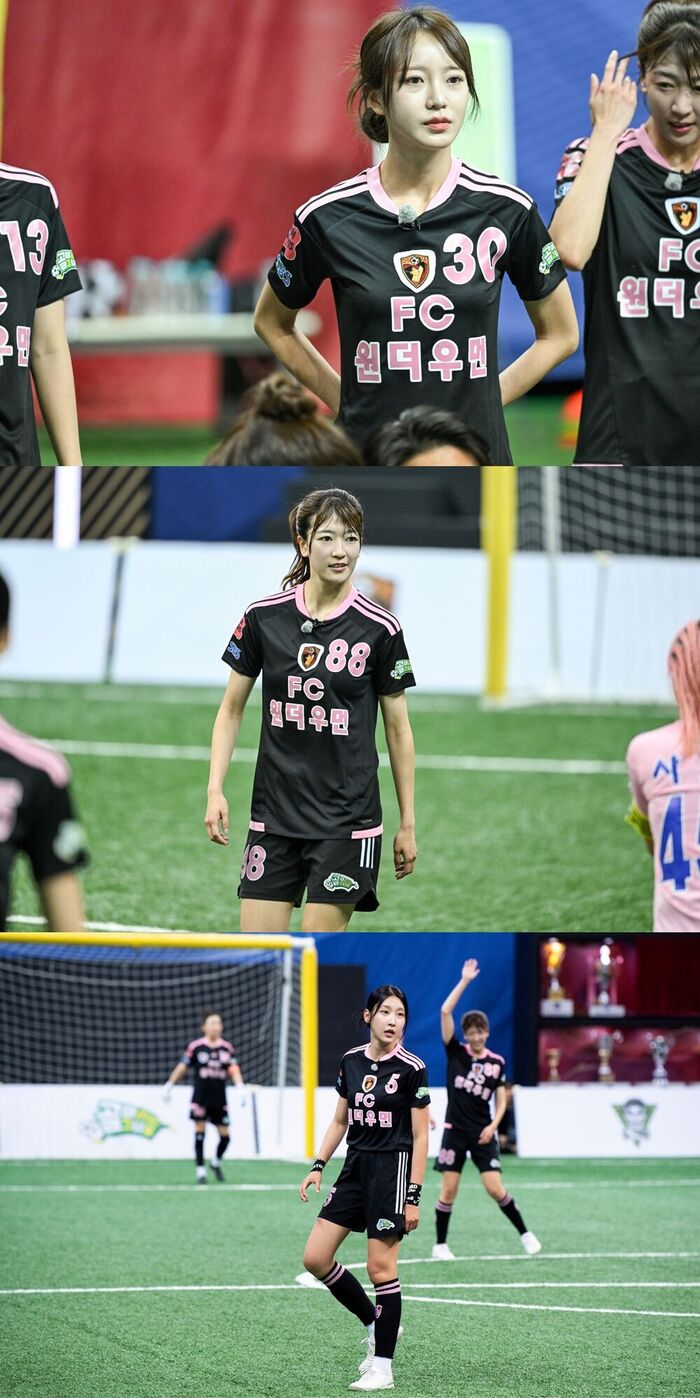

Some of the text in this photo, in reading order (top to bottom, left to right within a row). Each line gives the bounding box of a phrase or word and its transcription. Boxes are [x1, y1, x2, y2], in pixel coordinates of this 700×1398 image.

[442, 226, 508, 285] 30
[390, 294, 455, 332] FC
[617, 276, 700, 318] 원더
[354, 335, 488, 384] 원더우먼
[325, 638, 371, 678] 88
[287, 675, 325, 701] FC
[269, 699, 349, 736] 원더우먼
[240, 843, 267, 881] 8
[659, 796, 700, 892] 4
[354, 1092, 376, 1108] FC
